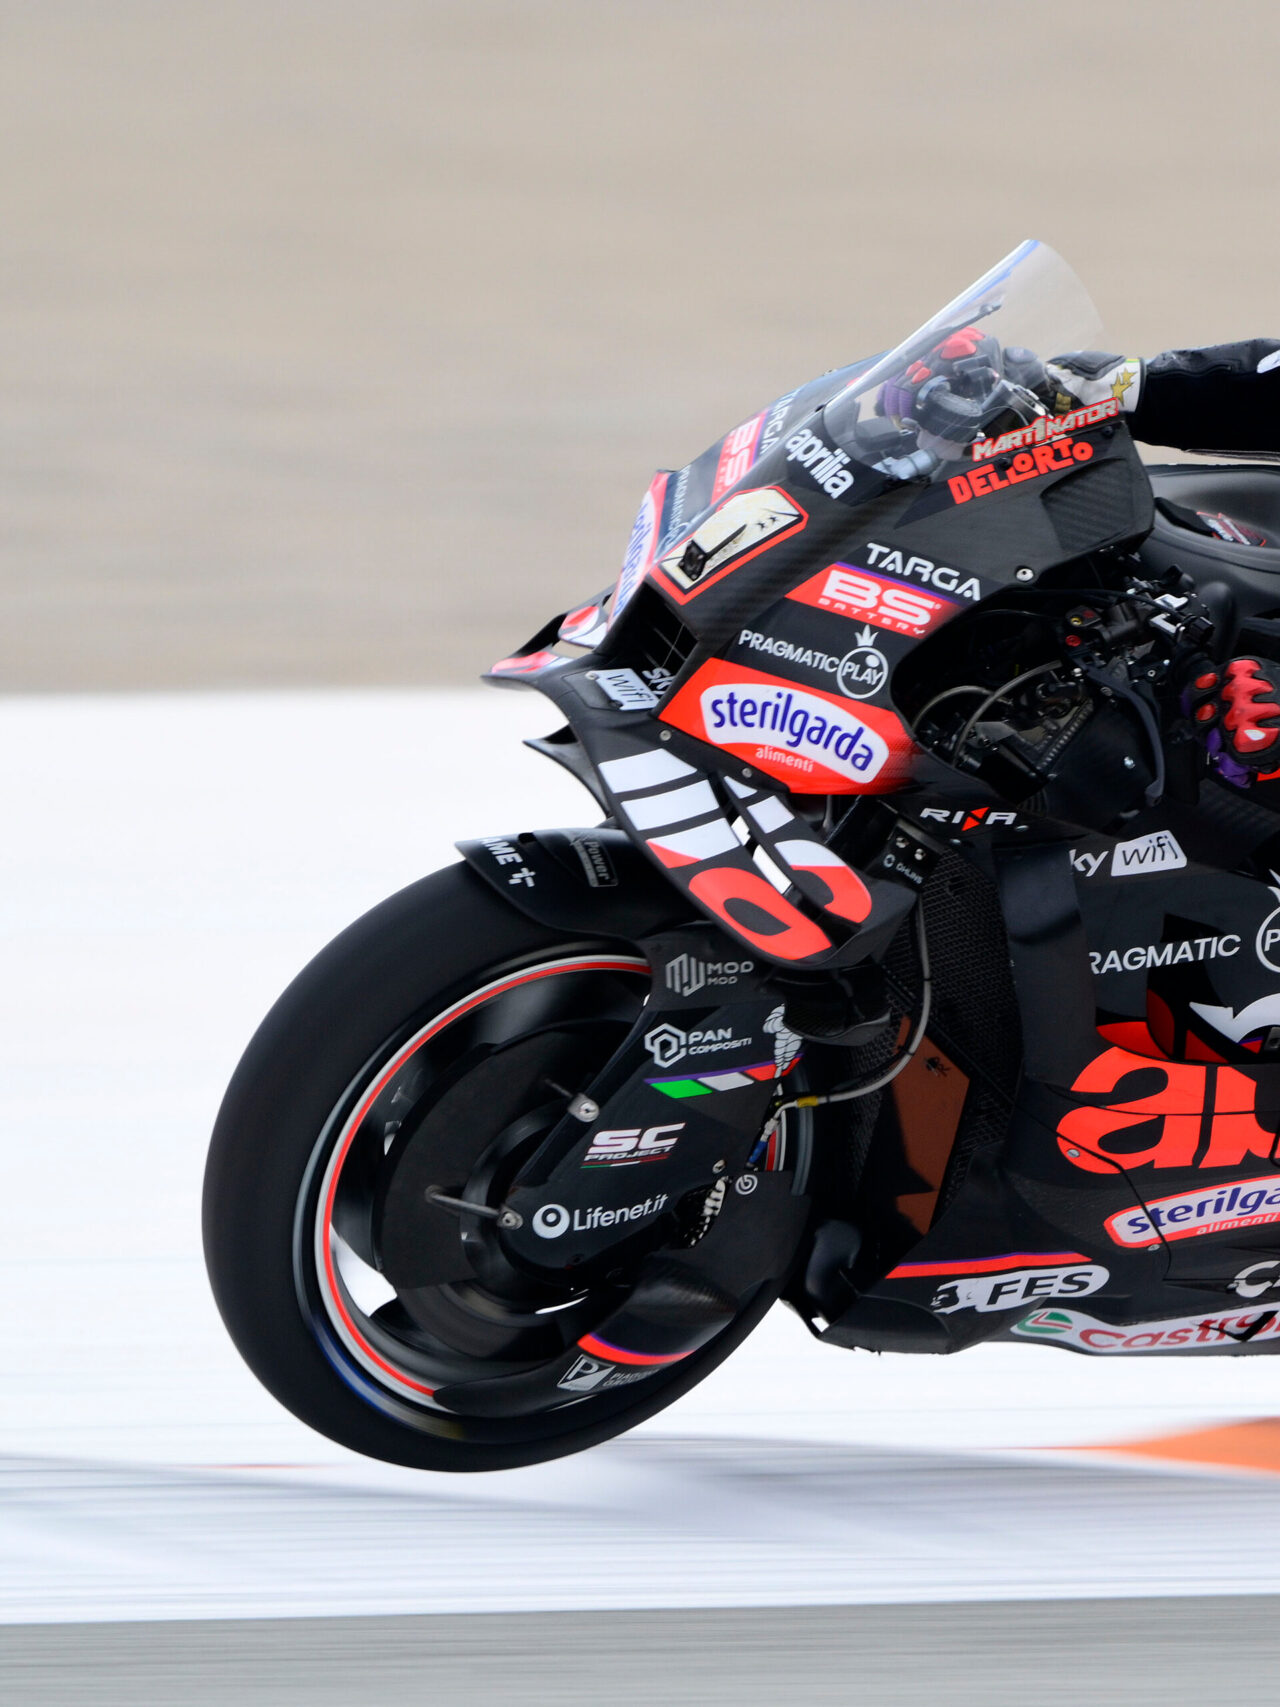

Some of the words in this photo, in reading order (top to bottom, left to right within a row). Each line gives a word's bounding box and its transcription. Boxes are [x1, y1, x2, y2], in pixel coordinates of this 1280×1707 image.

[785, 429, 854, 499] aprilia
[867, 542, 981, 601] TARGA
[822, 570, 936, 626] BS
[818, 597, 927, 635] BATTERY
[738, 629, 839, 674] PRAGMATIC
[841, 661, 884, 686] PLAY
[607, 674, 655, 703] wifi
[711, 692, 875, 772] sterilgarda
[756, 745, 814, 773] alimenti
[1070, 849, 1109, 878] ky
[1122, 834, 1181, 867] wifi
[707, 960, 755, 975] MOD
[707, 975, 738, 986] MOD
[688, 1027, 733, 1045] PAN
[688, 1037, 752, 1056] COMPOSITI
[584, 1145, 675, 1161] PROJECT
[588, 1122, 686, 1154] SC
[573, 1193, 668, 1231] Lifenet.it
[1196, 1212, 1280, 1235] alimenti
